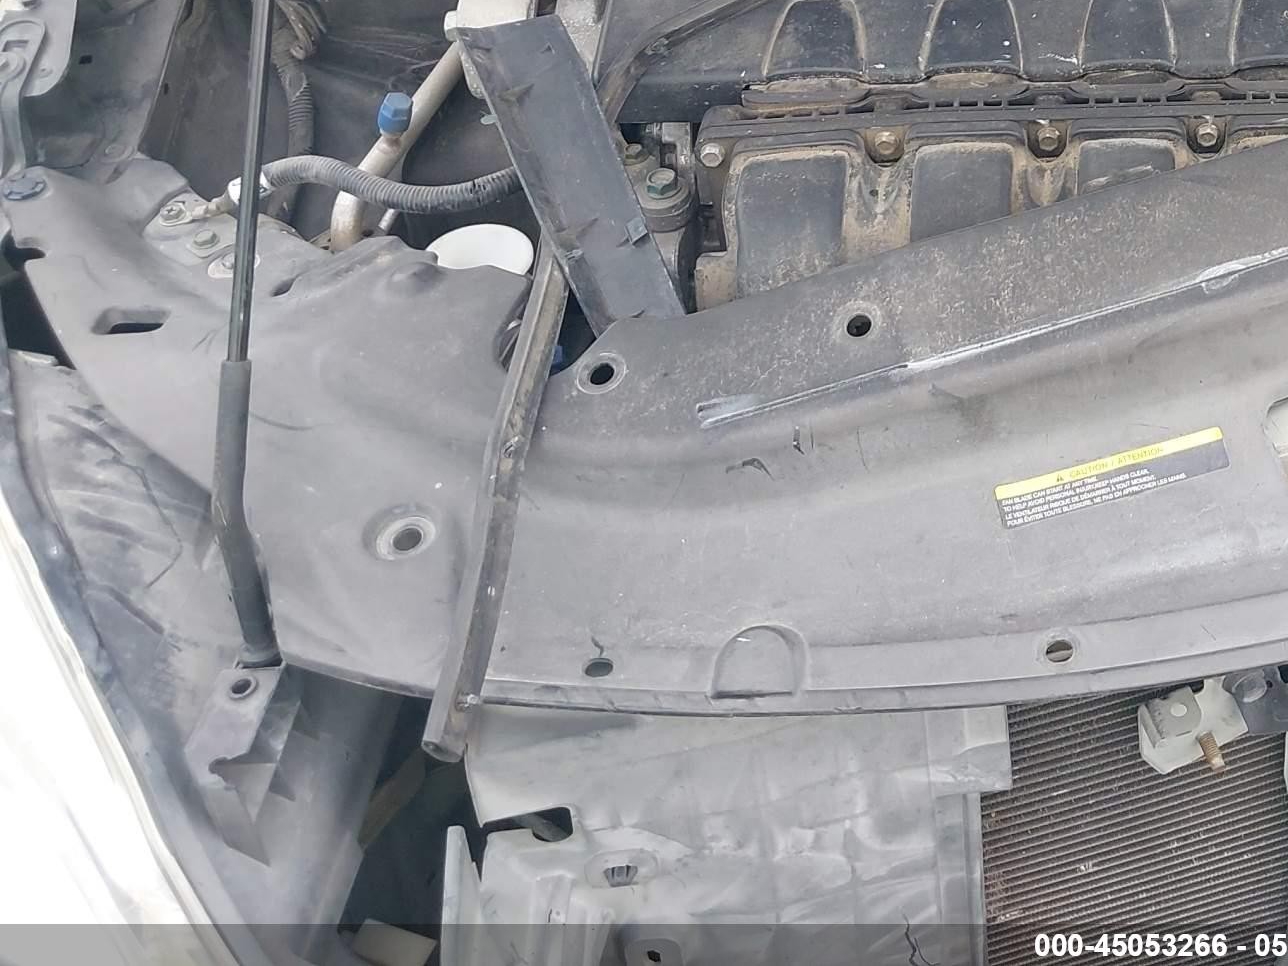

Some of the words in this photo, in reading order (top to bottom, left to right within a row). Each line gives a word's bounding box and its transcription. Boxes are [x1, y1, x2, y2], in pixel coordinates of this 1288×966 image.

[1069, 461, 1109, 478] CAUTION
[1117, 446, 1164, 465] ATTENTION
[1001, 498, 1014, 507] FAN
[1014, 493, 1033, 504] BLADE
[1033, 490, 1046, 498] CAN
[1045, 484, 1065, 495] START
[1003, 505, 1013, 514] TO
[1012, 501, 1027, 511] HELP
[1026, 496, 1046, 507] AVOID
[1045, 488, 1076, 502] PERSONAL
[1109, 473, 1130, 484] HANDS
[1005, 513, 1013, 521] LE
[1012, 503, 1049, 519] VENTILATEUR
[1049, 497, 1071, 508] RISQUE
[1116, 480, 1131, 490] TOUT
[1007, 517, 1024, 528] POUR
[1043, 506, 1063, 517] TOUTE
[1122, 480, 1158, 496] APPROCHER
[1157, 477, 1168, 486] LES
